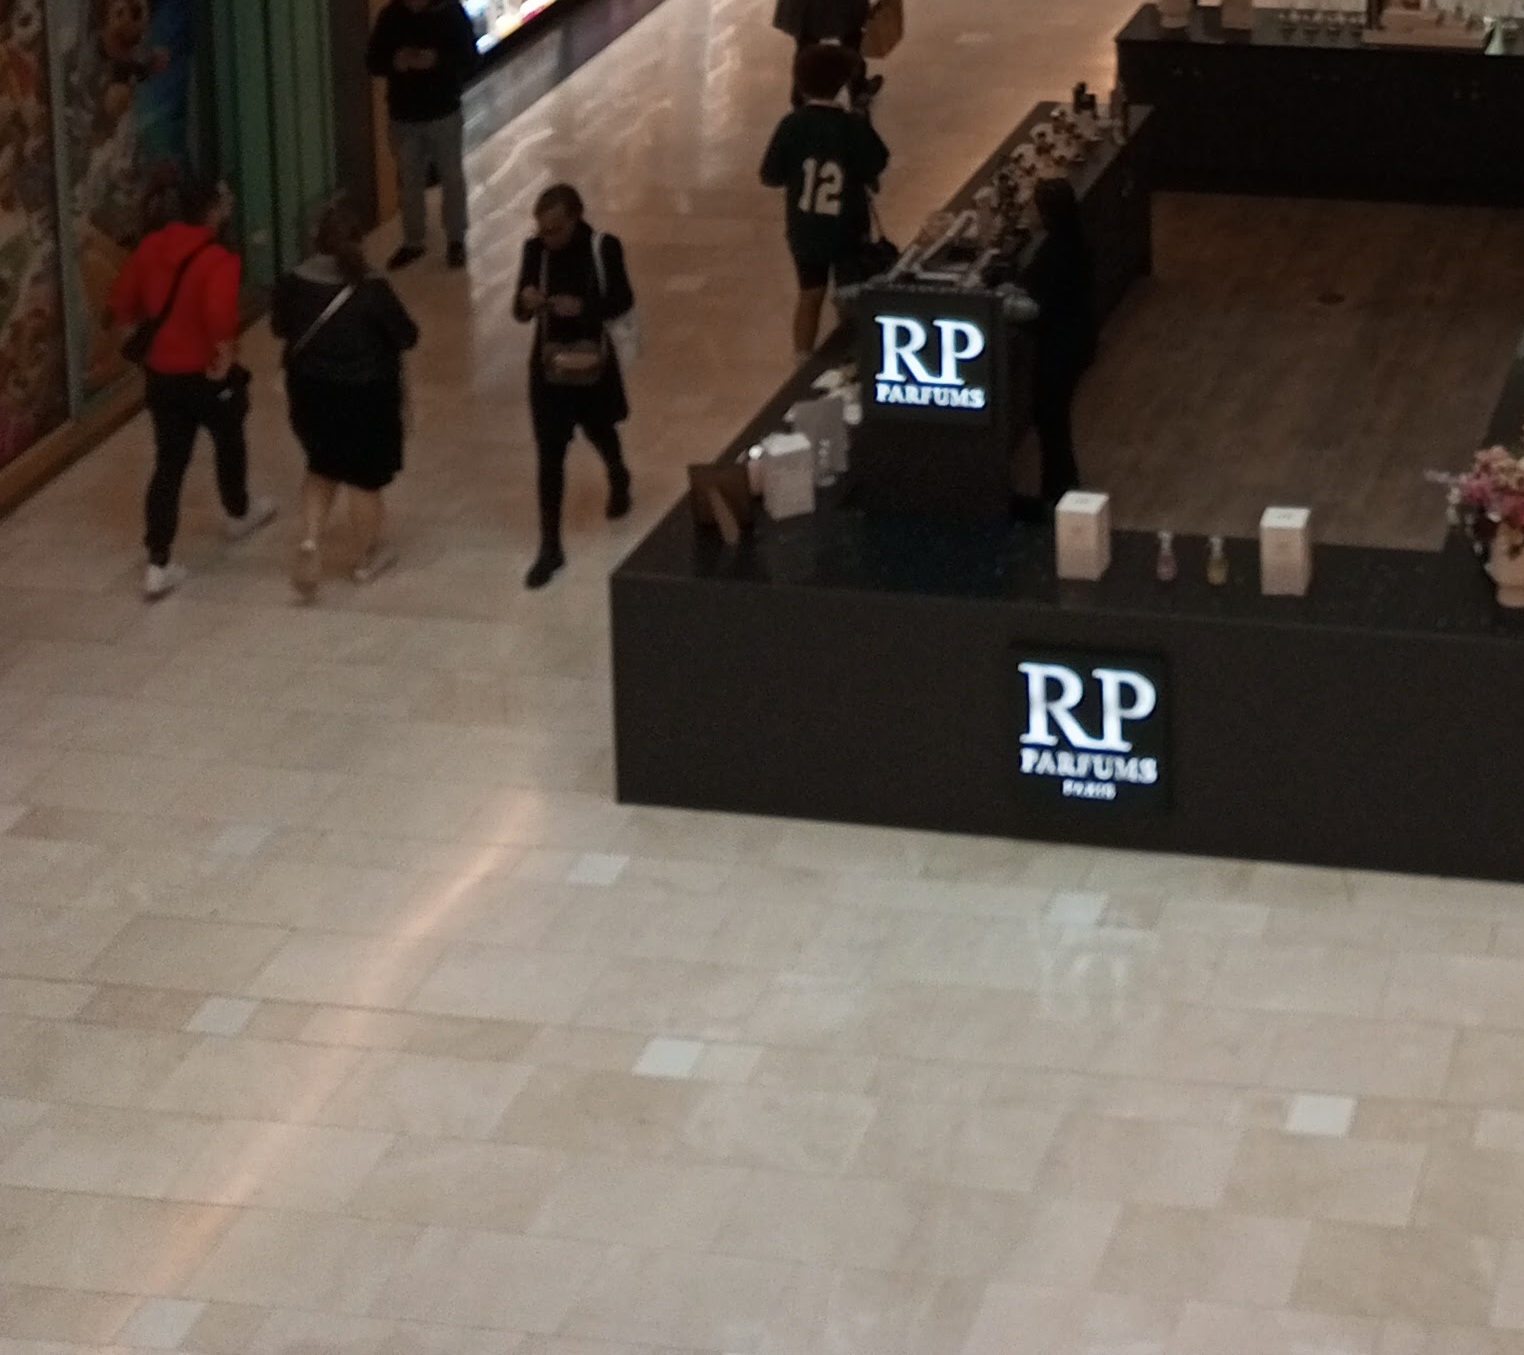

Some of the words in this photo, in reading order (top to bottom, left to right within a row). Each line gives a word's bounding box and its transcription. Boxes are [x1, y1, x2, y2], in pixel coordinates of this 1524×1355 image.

[799, 158, 844, 217] 12
[874, 315, 985, 386] RP
[876, 383, 986, 409] PARFUMS
[1017, 661, 1157, 753] RP
[1020, 747, 1158, 784] PARFUMS
